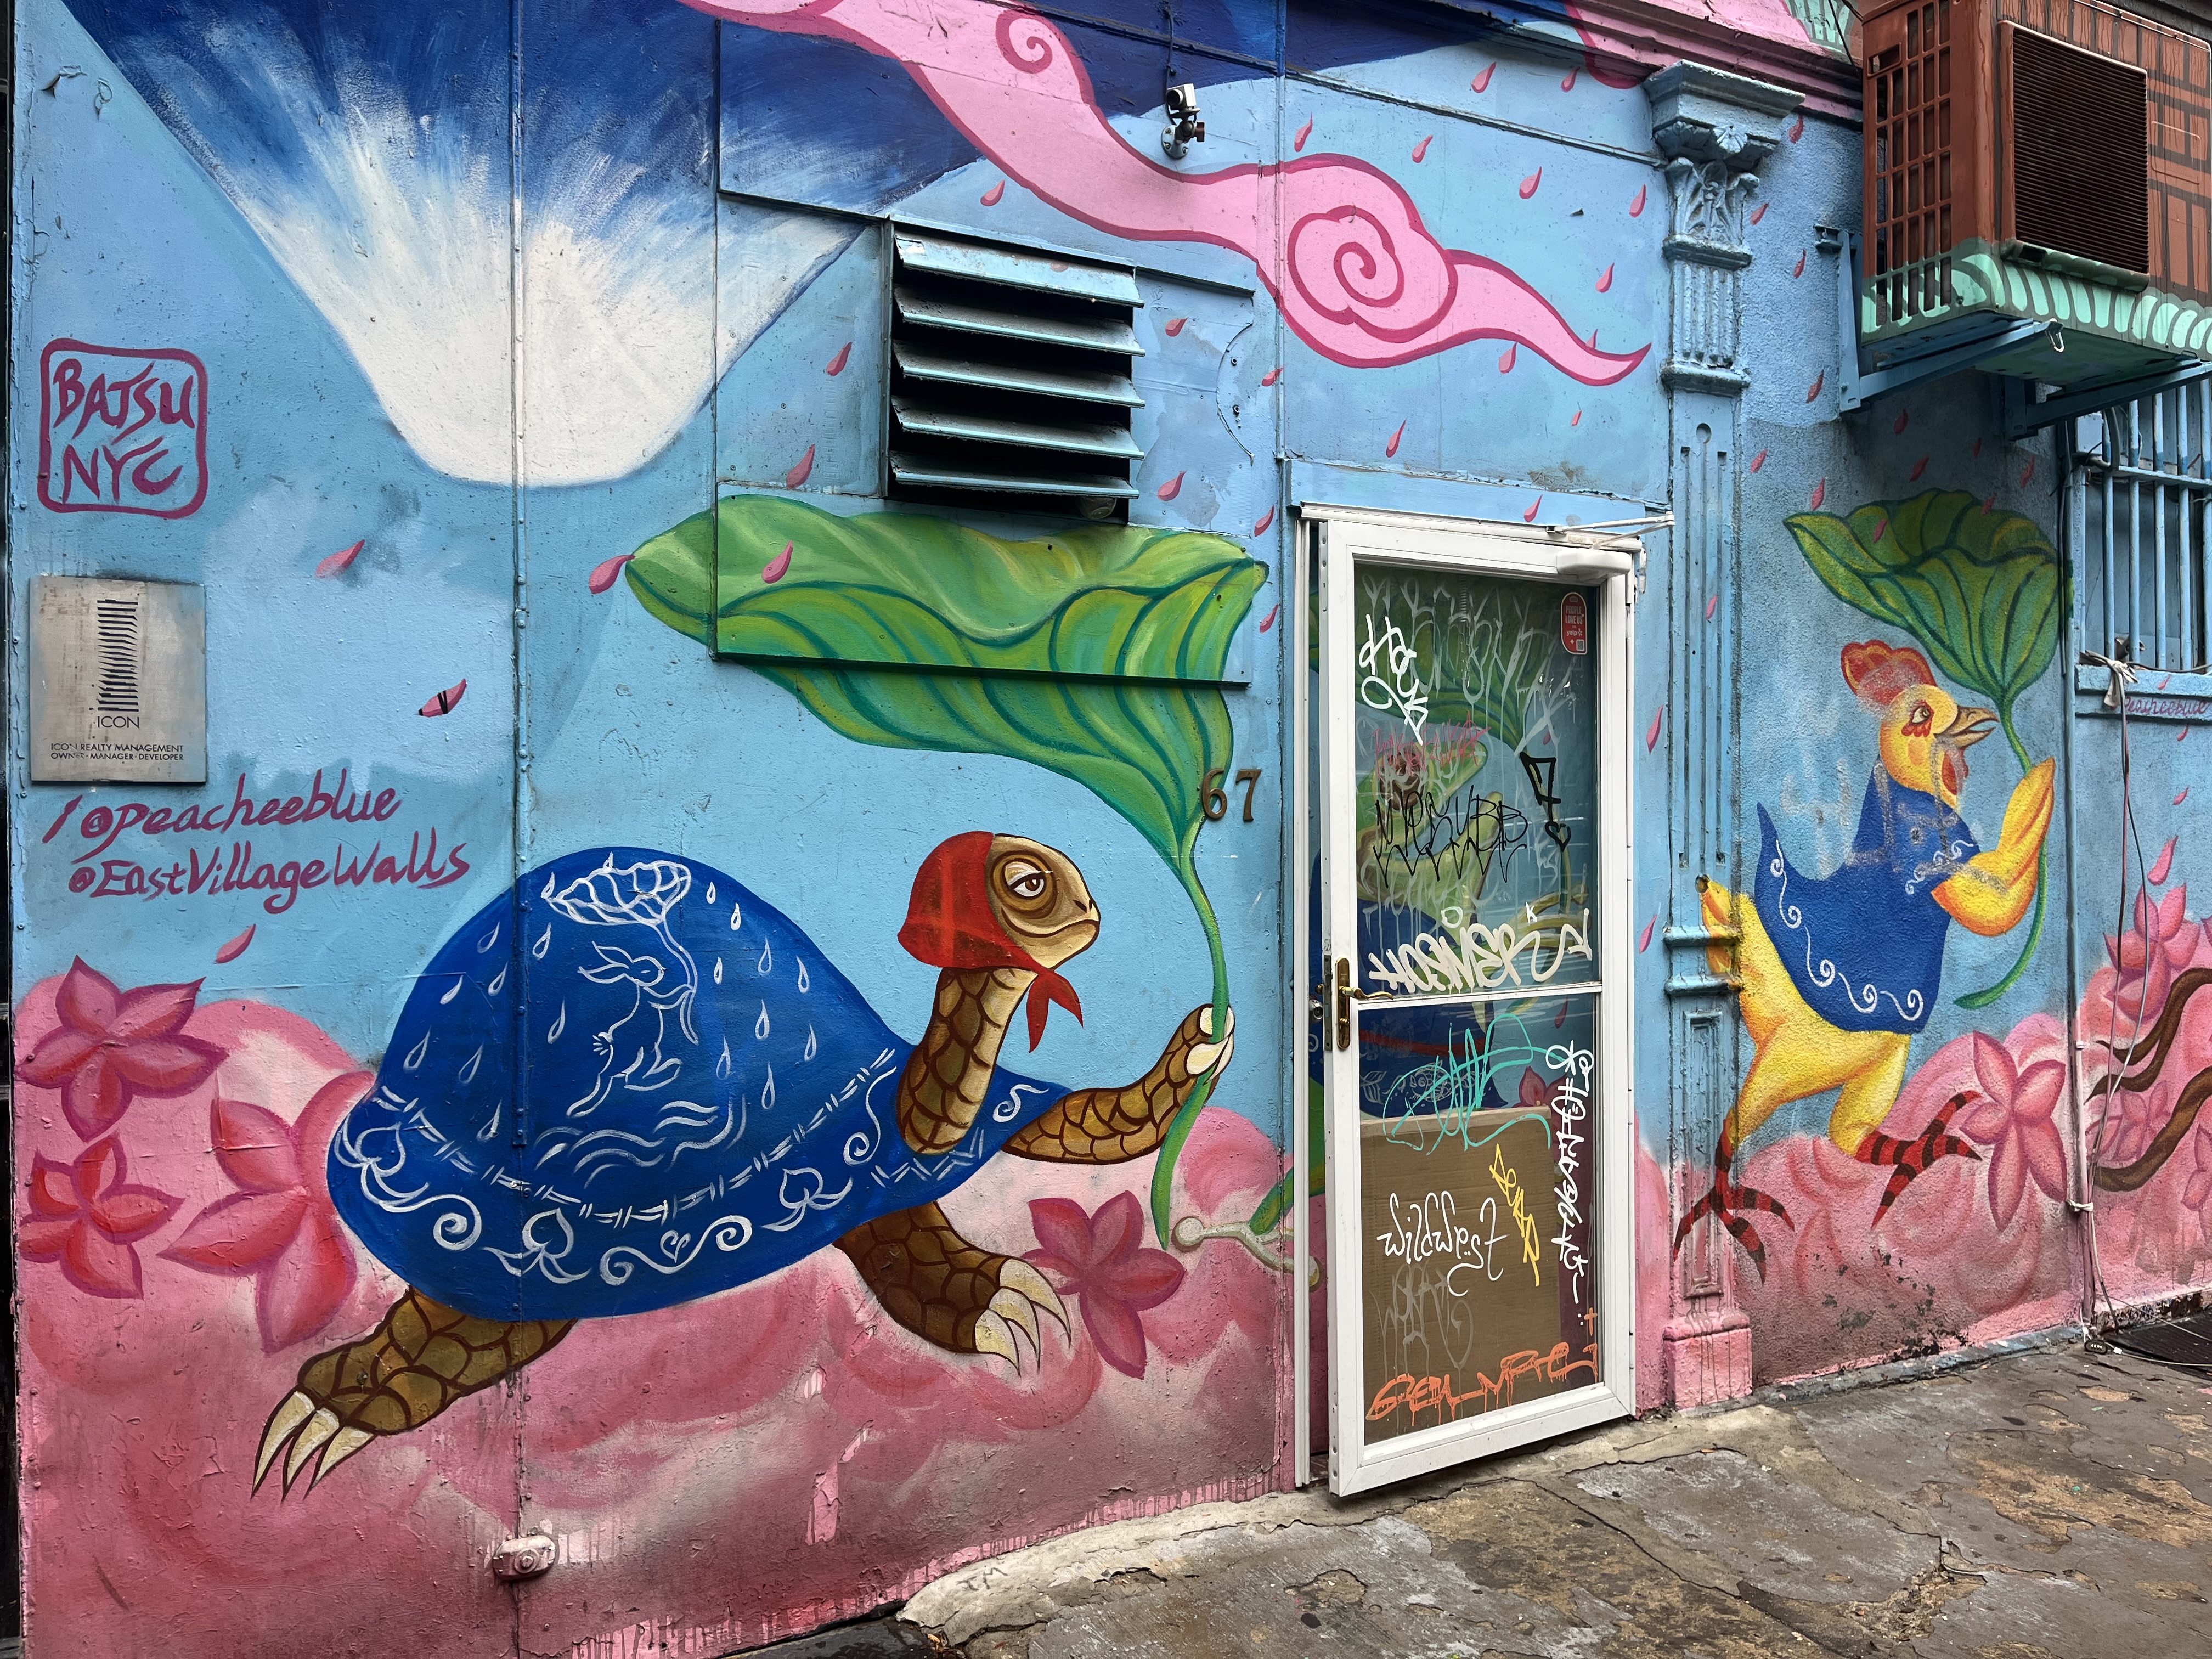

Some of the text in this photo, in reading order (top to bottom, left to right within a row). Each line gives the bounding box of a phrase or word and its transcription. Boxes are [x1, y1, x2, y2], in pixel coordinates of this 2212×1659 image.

[62, 436, 183, 504] NYC
[1565, 605, 1582, 614] PEOPLE
[1565, 614, 1583, 624] LOVE US
[98, 715, 139, 729] ICON
[51, 743, 184, 753] ICON REALTY MANAGEMENT
[1202, 768, 1262, 822] 67
